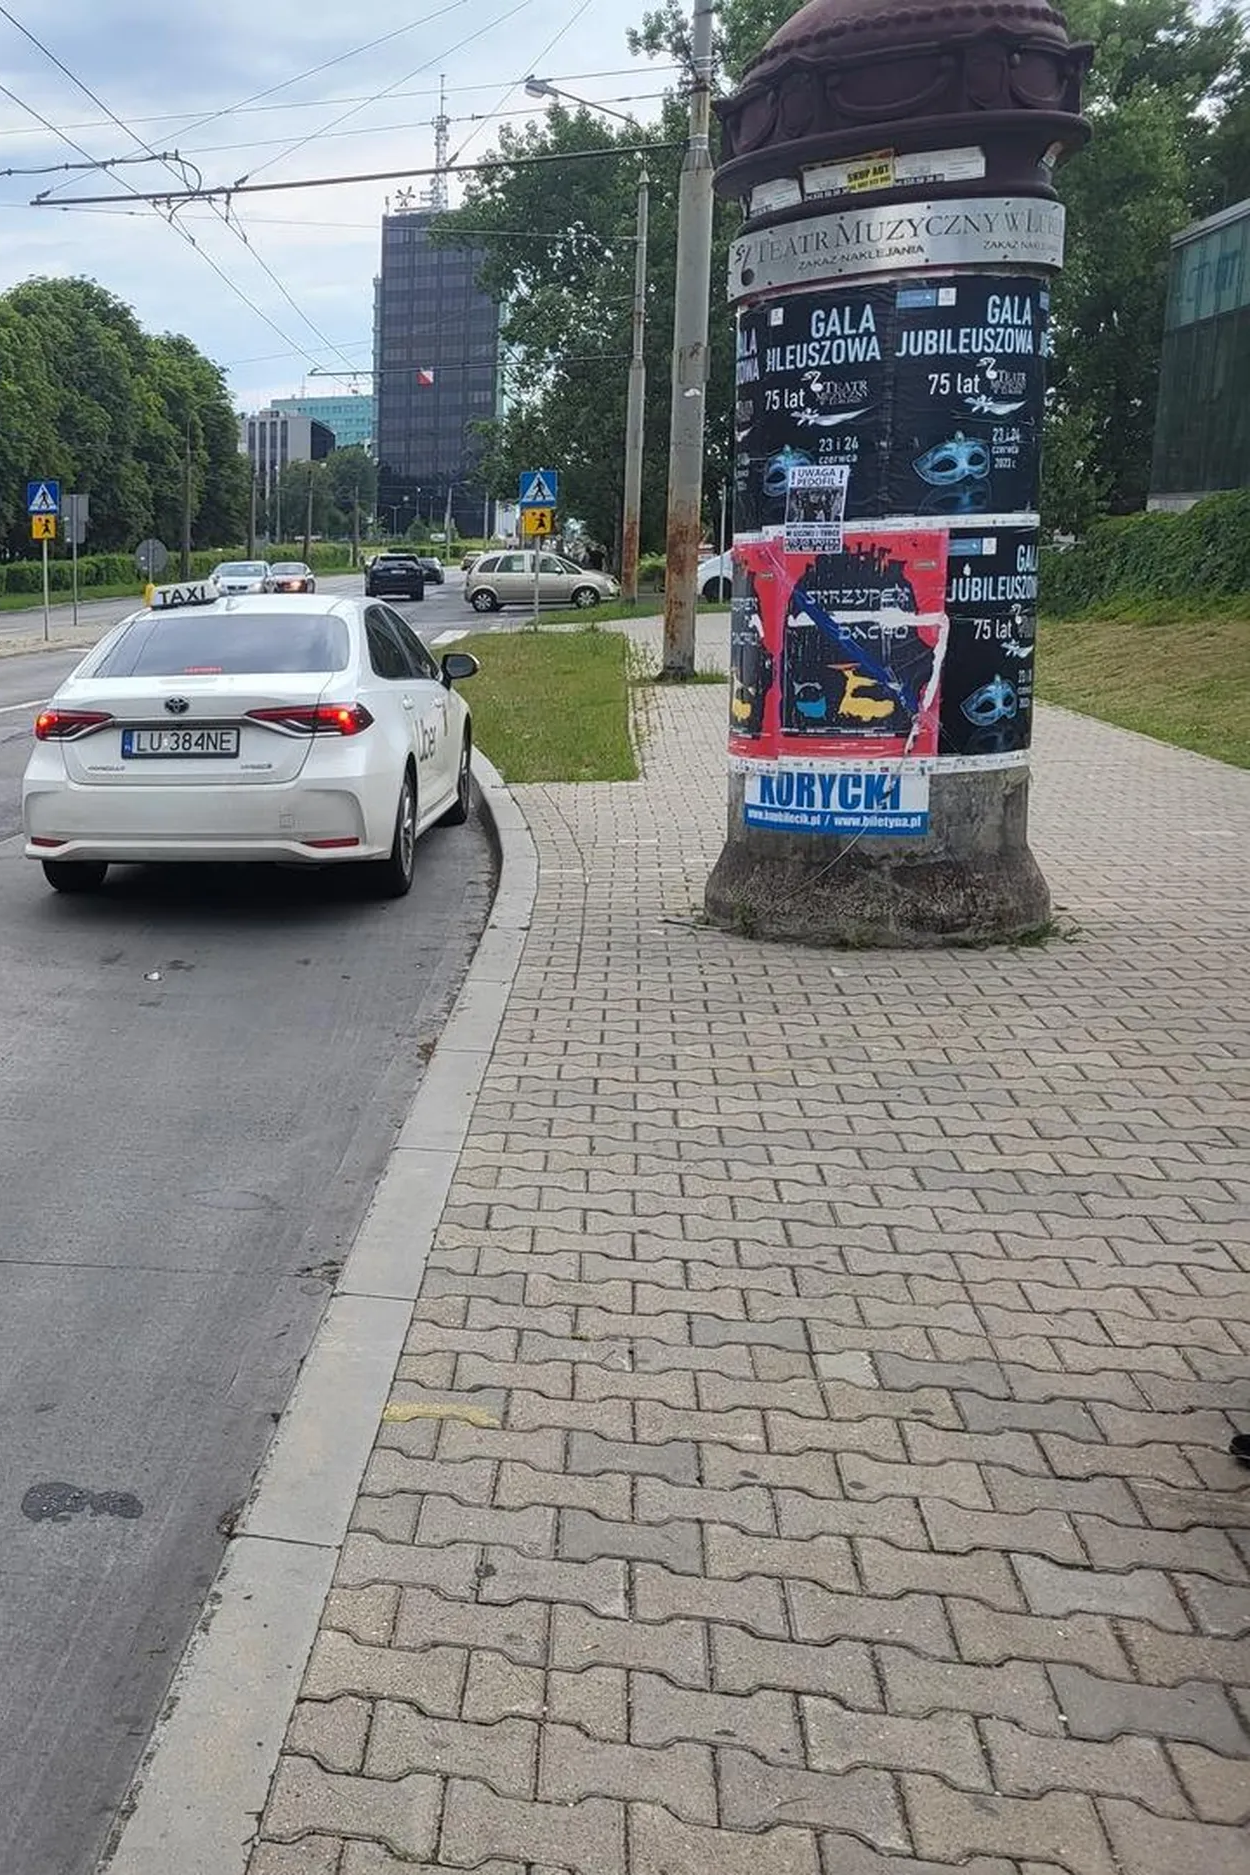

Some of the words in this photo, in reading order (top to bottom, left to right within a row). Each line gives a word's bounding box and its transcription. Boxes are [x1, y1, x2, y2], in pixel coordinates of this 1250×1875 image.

[758, 229, 830, 263] TEATR
[836, 212, 999, 248] MUZYCZNY
[983, 240, 1019, 250] ZAKAZ
[799, 255, 839, 270] ZAKAZ
[840, 244, 925, 263] NAKLEJANIA
[811, 303, 877, 339] GALA
[987, 294, 1032, 326] GALA
[895, 327, 1034, 358] JUBILEUSZOWA
[928, 373, 950, 396] 75
[956, 372, 981, 395] lat
[765, 388, 781, 412] 75
[784, 387, 806, 410] lat
[819, 438, 833, 452] 23
[836, 436, 841, 451] i
[844, 435, 859, 450] 24
[797, 467, 836, 478] UWAGA
[158, 585, 205, 605] TAXI
[805, 587, 910, 609] SKRZYPEK
[974, 618, 992, 640] 75
[995, 617, 1013, 639] lat
[136, 731, 163, 751] LU
[169, 731, 232, 752] 384NE
[760, 772, 902, 811] KORYCKI
